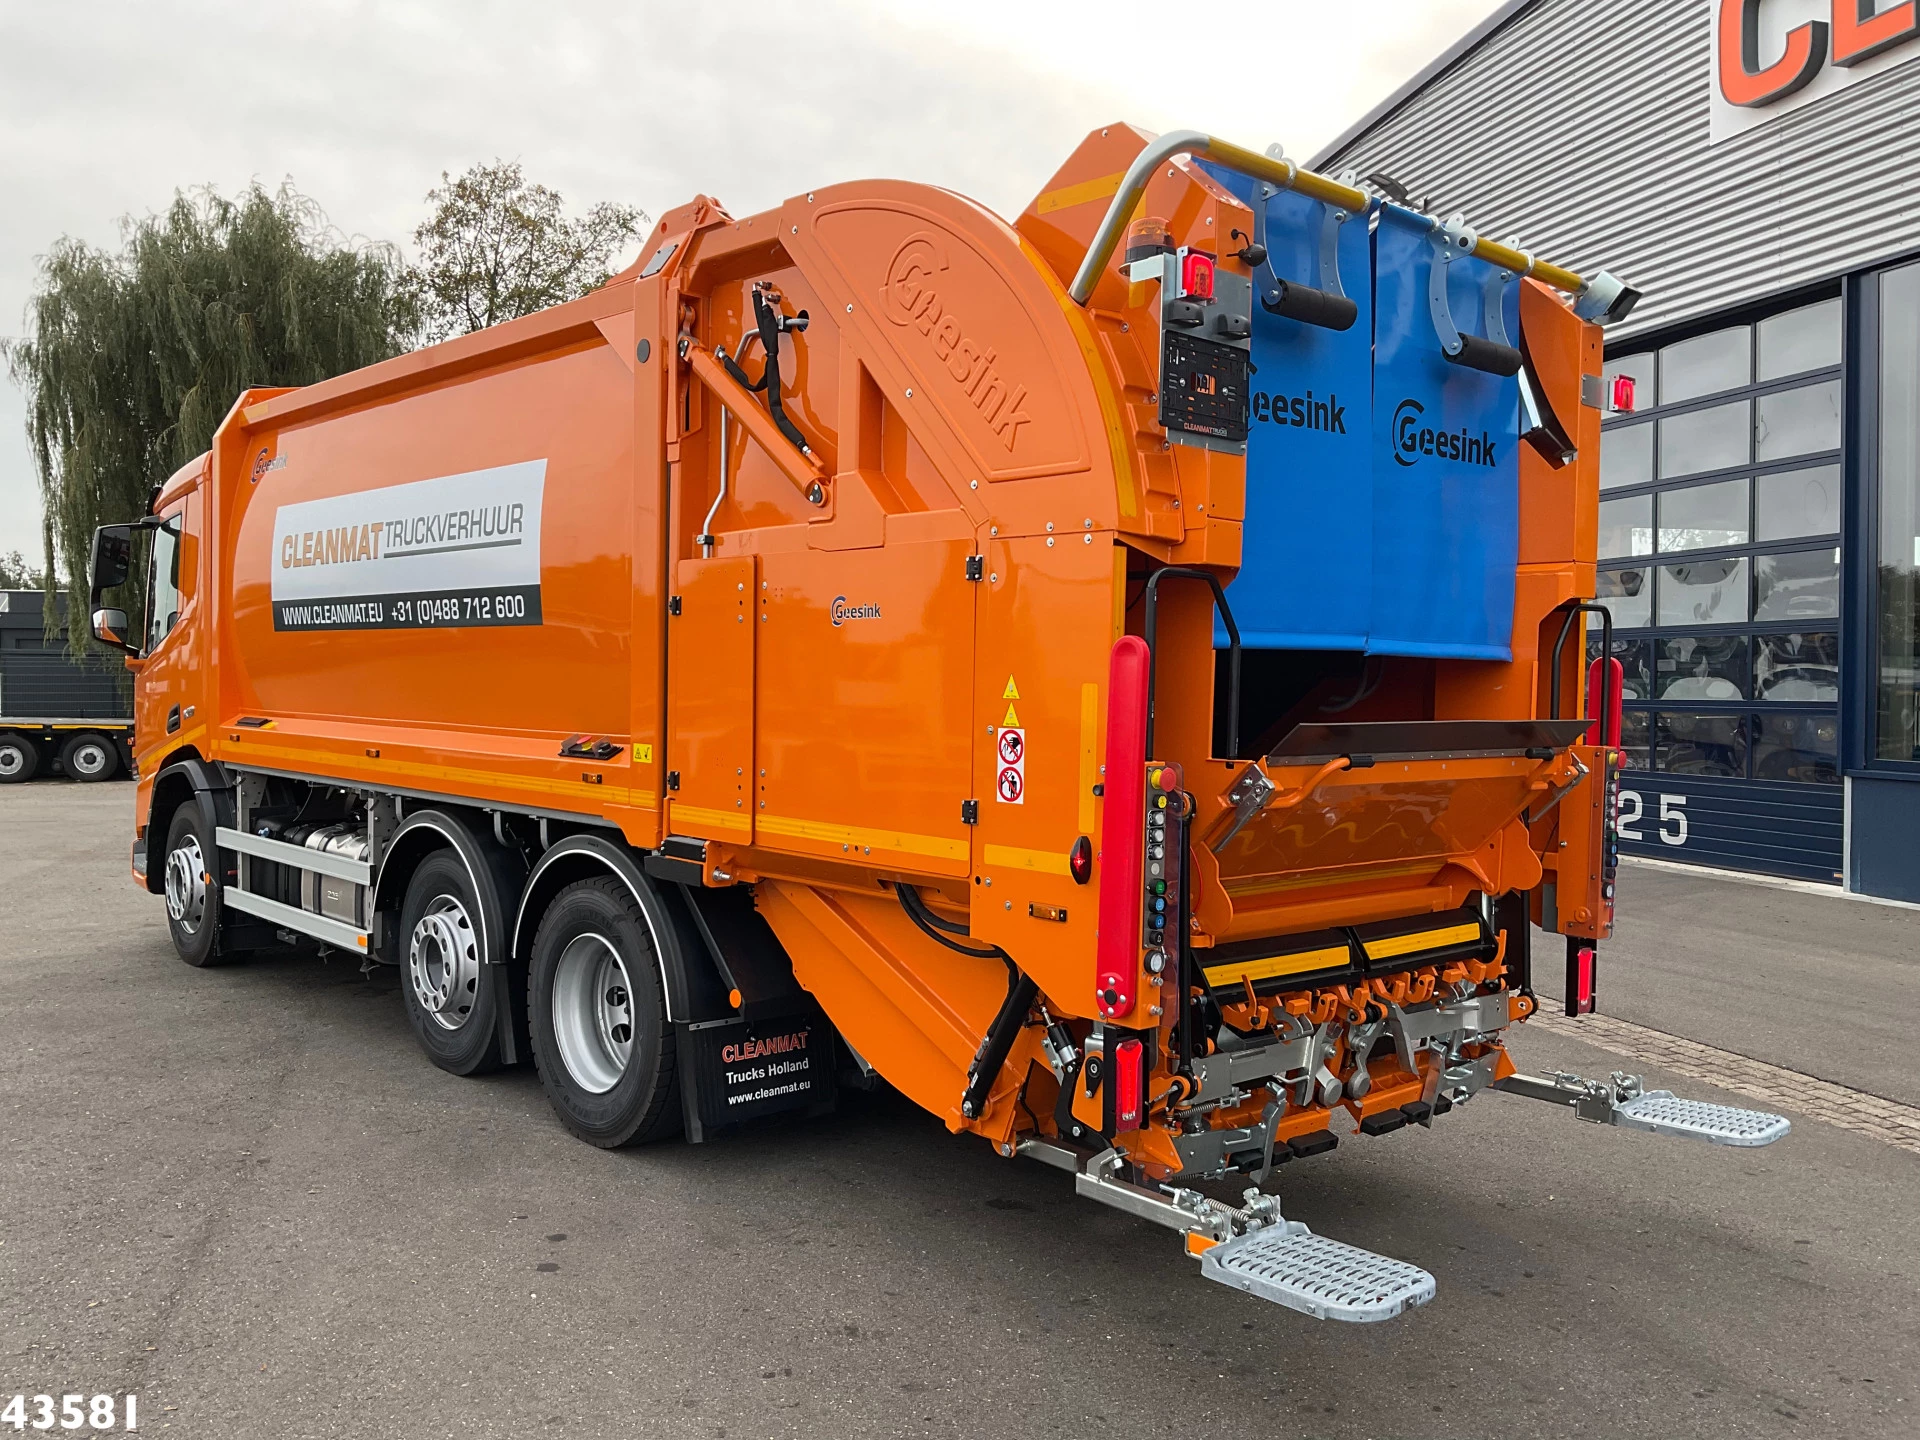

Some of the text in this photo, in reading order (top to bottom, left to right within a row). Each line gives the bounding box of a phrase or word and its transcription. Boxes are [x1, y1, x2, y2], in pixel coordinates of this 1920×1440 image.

[879, 230, 1032, 453] Geesink
[1248, 390, 1347, 434] eesink
[1392, 398, 1497, 467] Geesink
[282, 594, 525, 626] WWW.CLEANMAT.EU +31 (0)488 712 600
[831, 595, 881, 626] Geesink
[722, 1031, 808, 1063] CLEANMAT
[726, 1057, 809, 1085] Trucks Holland
[728, 1081, 811, 1105] www.cleanmat.eu
